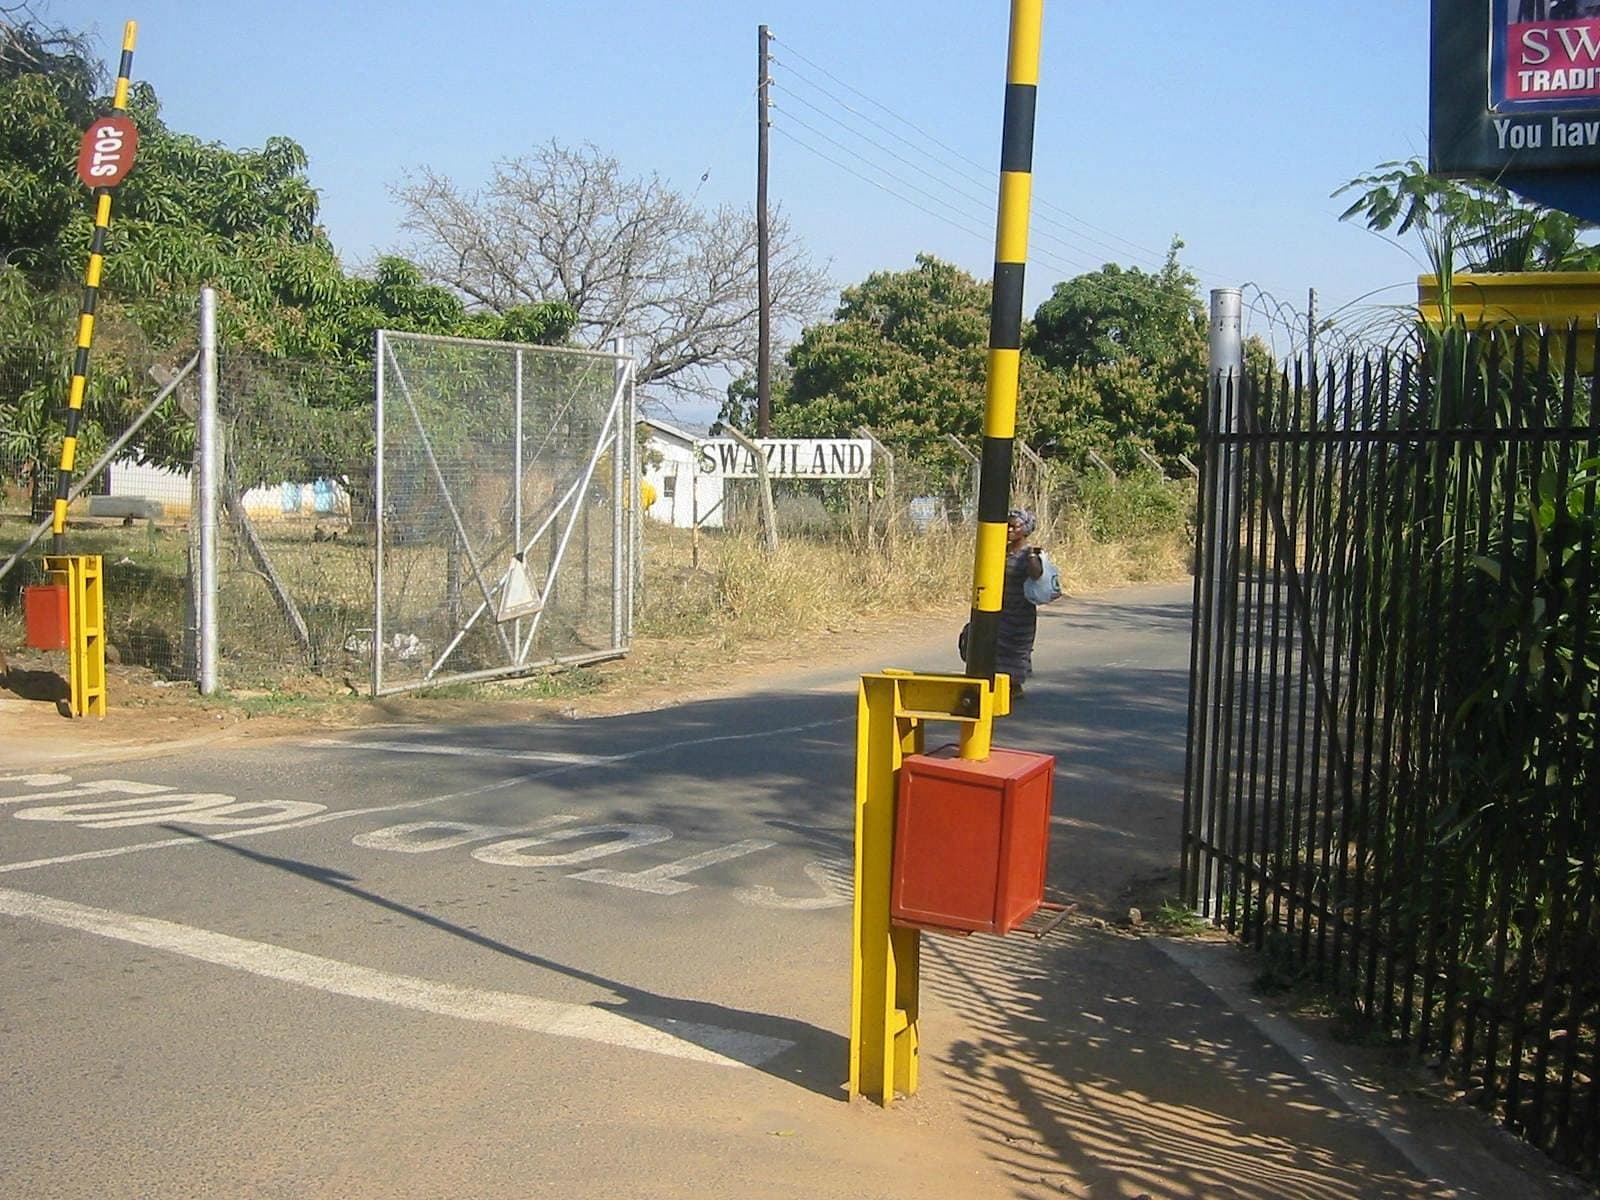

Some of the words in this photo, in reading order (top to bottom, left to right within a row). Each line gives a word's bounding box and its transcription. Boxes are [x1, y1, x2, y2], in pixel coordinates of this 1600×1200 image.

[1494, 119, 1541, 149] You
[1552, 117, 1600, 147] hav
[90, 126, 124, 176] STOP
[700, 443, 866, 474] SWAZILAND
